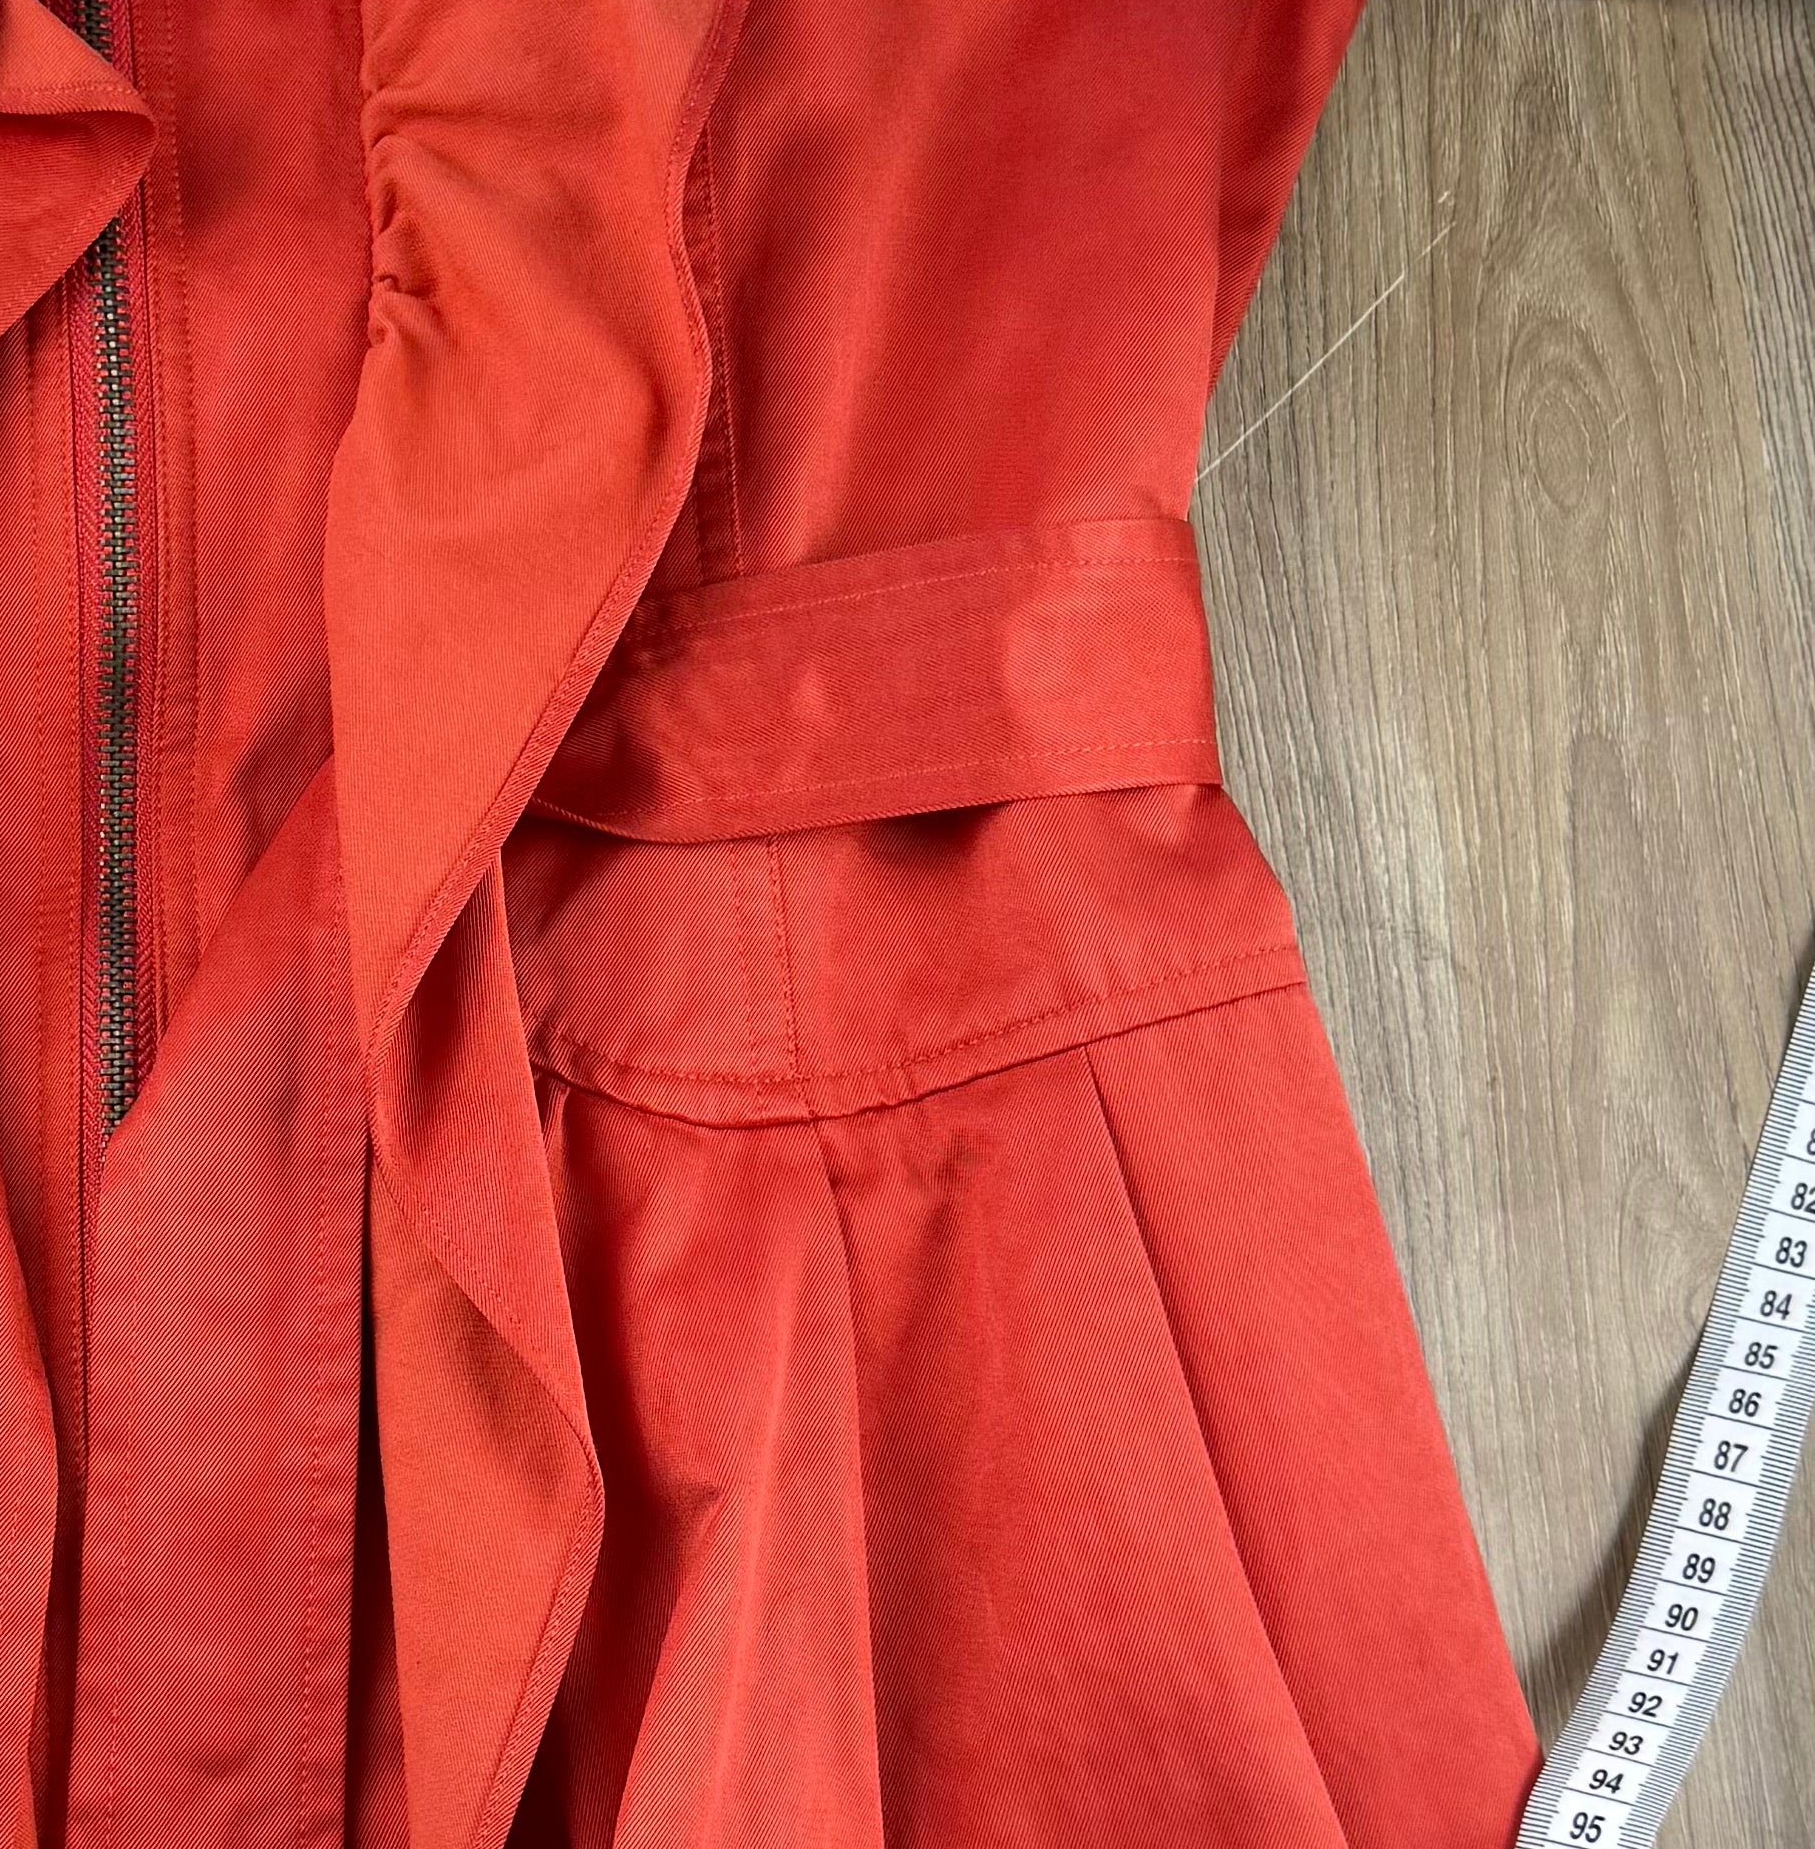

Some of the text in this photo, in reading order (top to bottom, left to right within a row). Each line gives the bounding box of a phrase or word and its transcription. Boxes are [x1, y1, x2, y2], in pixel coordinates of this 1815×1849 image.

[1775, 1236, 1808, 1269] 83
[1759, 1289, 1793, 1321] 84
[1744, 1341, 1779, 1370] 85
[1728, 1388, 1762, 1418] 86
[1713, 1440, 1749, 1473] 87
[1698, 1497, 1732, 1531] 88
[1682, 1553, 1716, 1584] 89
[1664, 1603, 1699, 1632] 90
[1646, 1648, 1679, 1675] 91
[1627, 1691, 1663, 1718] 92
[1608, 1731, 1644, 1756] 93
[1588, 1769, 1624, 1794] 94
[1569, 1811, 1606, 1844] 95
